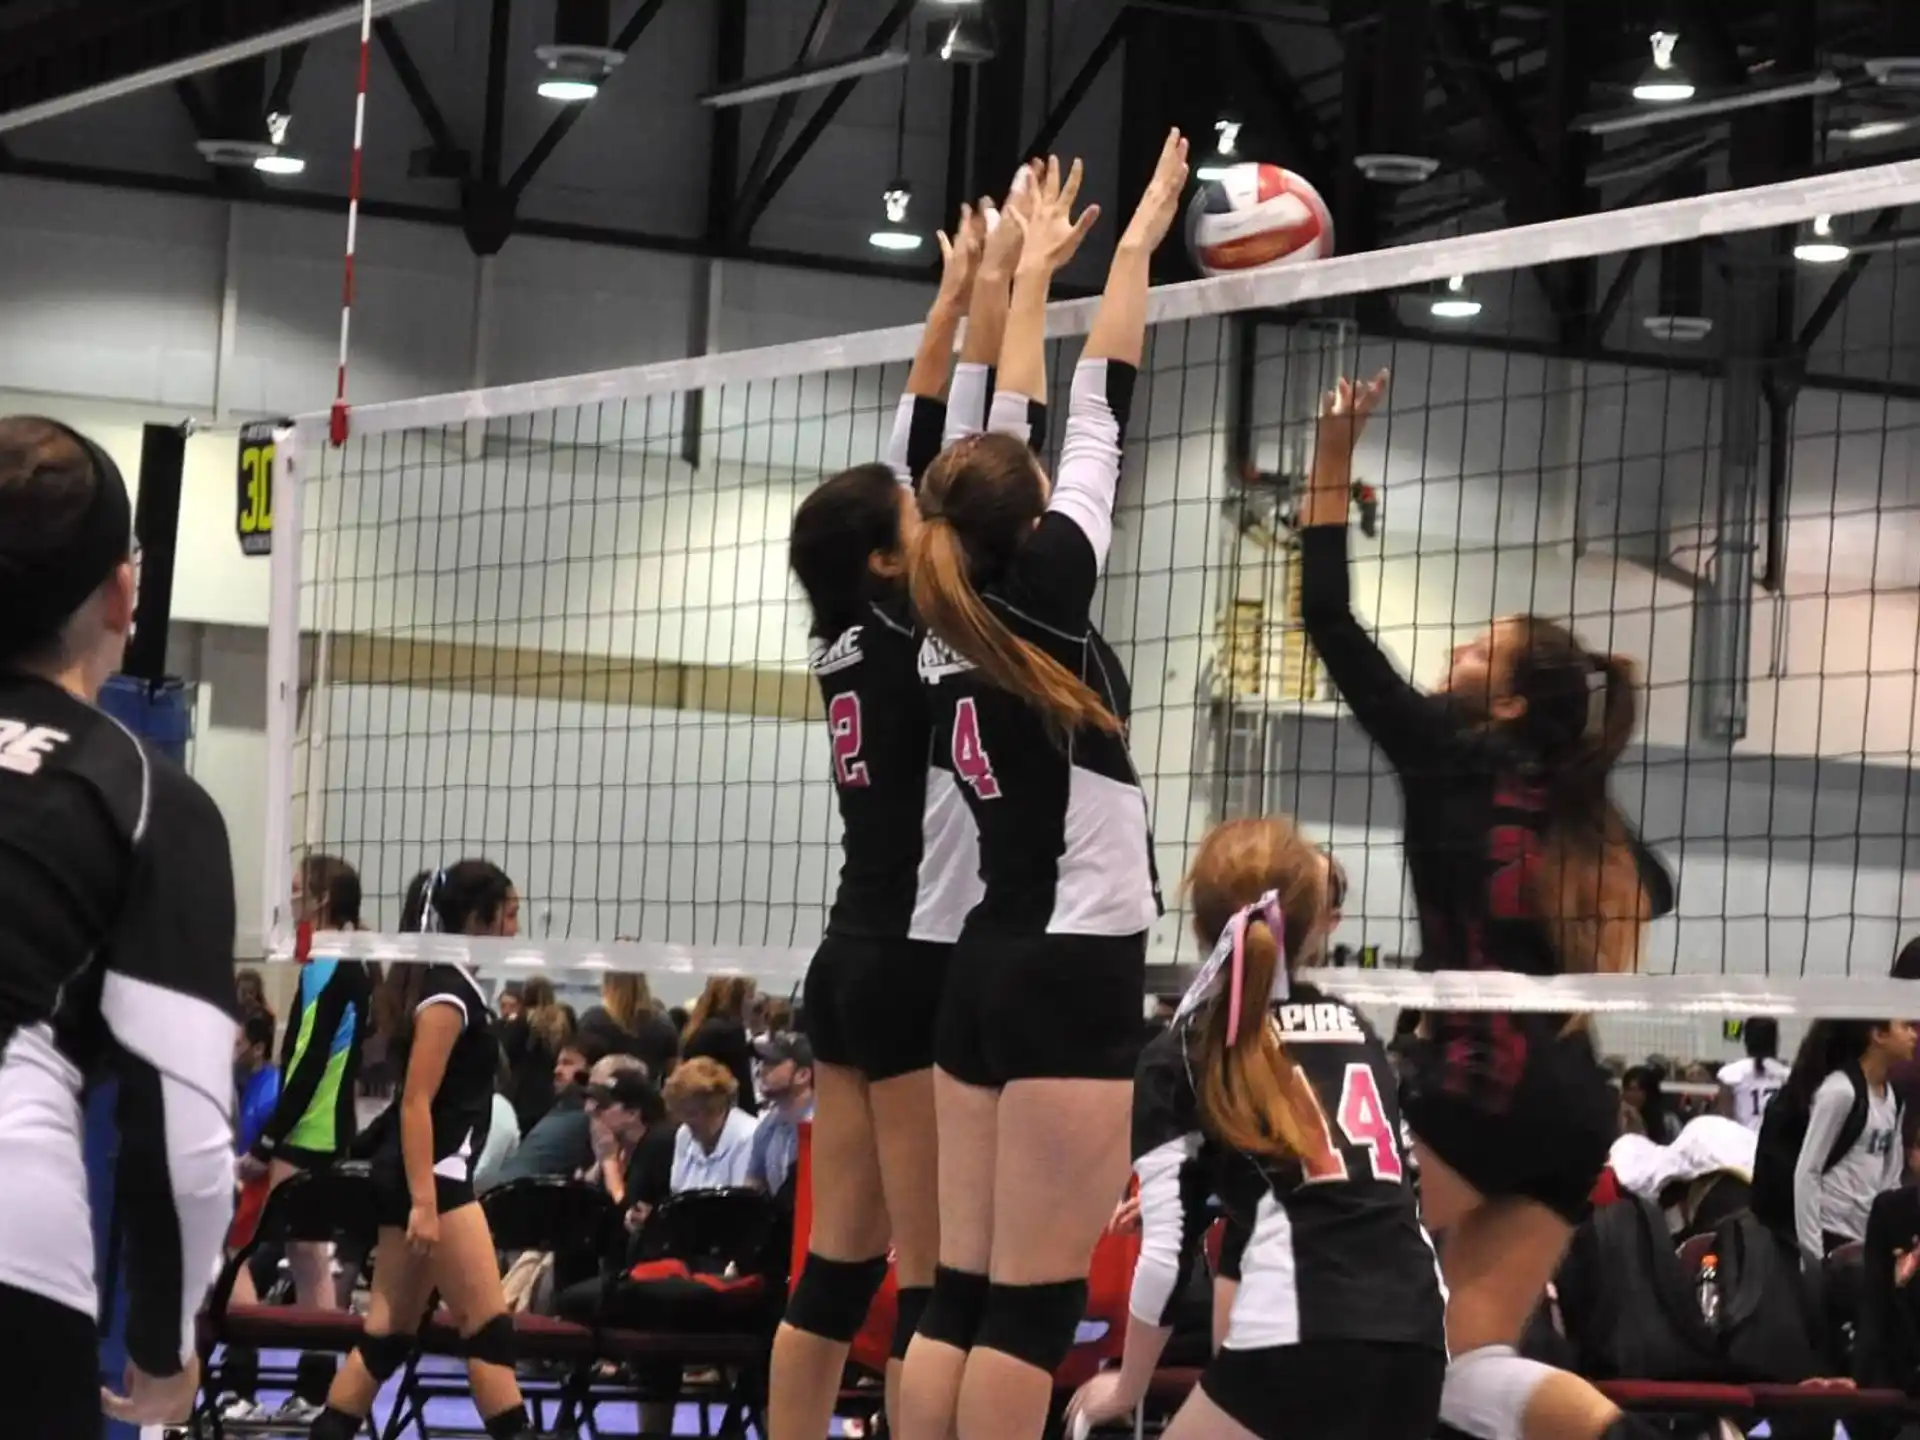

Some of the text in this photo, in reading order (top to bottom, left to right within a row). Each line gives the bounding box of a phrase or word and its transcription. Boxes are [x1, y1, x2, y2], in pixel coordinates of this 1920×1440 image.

[829, 690, 870, 787] 2
[952, 697, 1002, 800] 4
[1275, 1003, 1366, 1043] PIRE
[1293, 1062, 1402, 1185] 14
